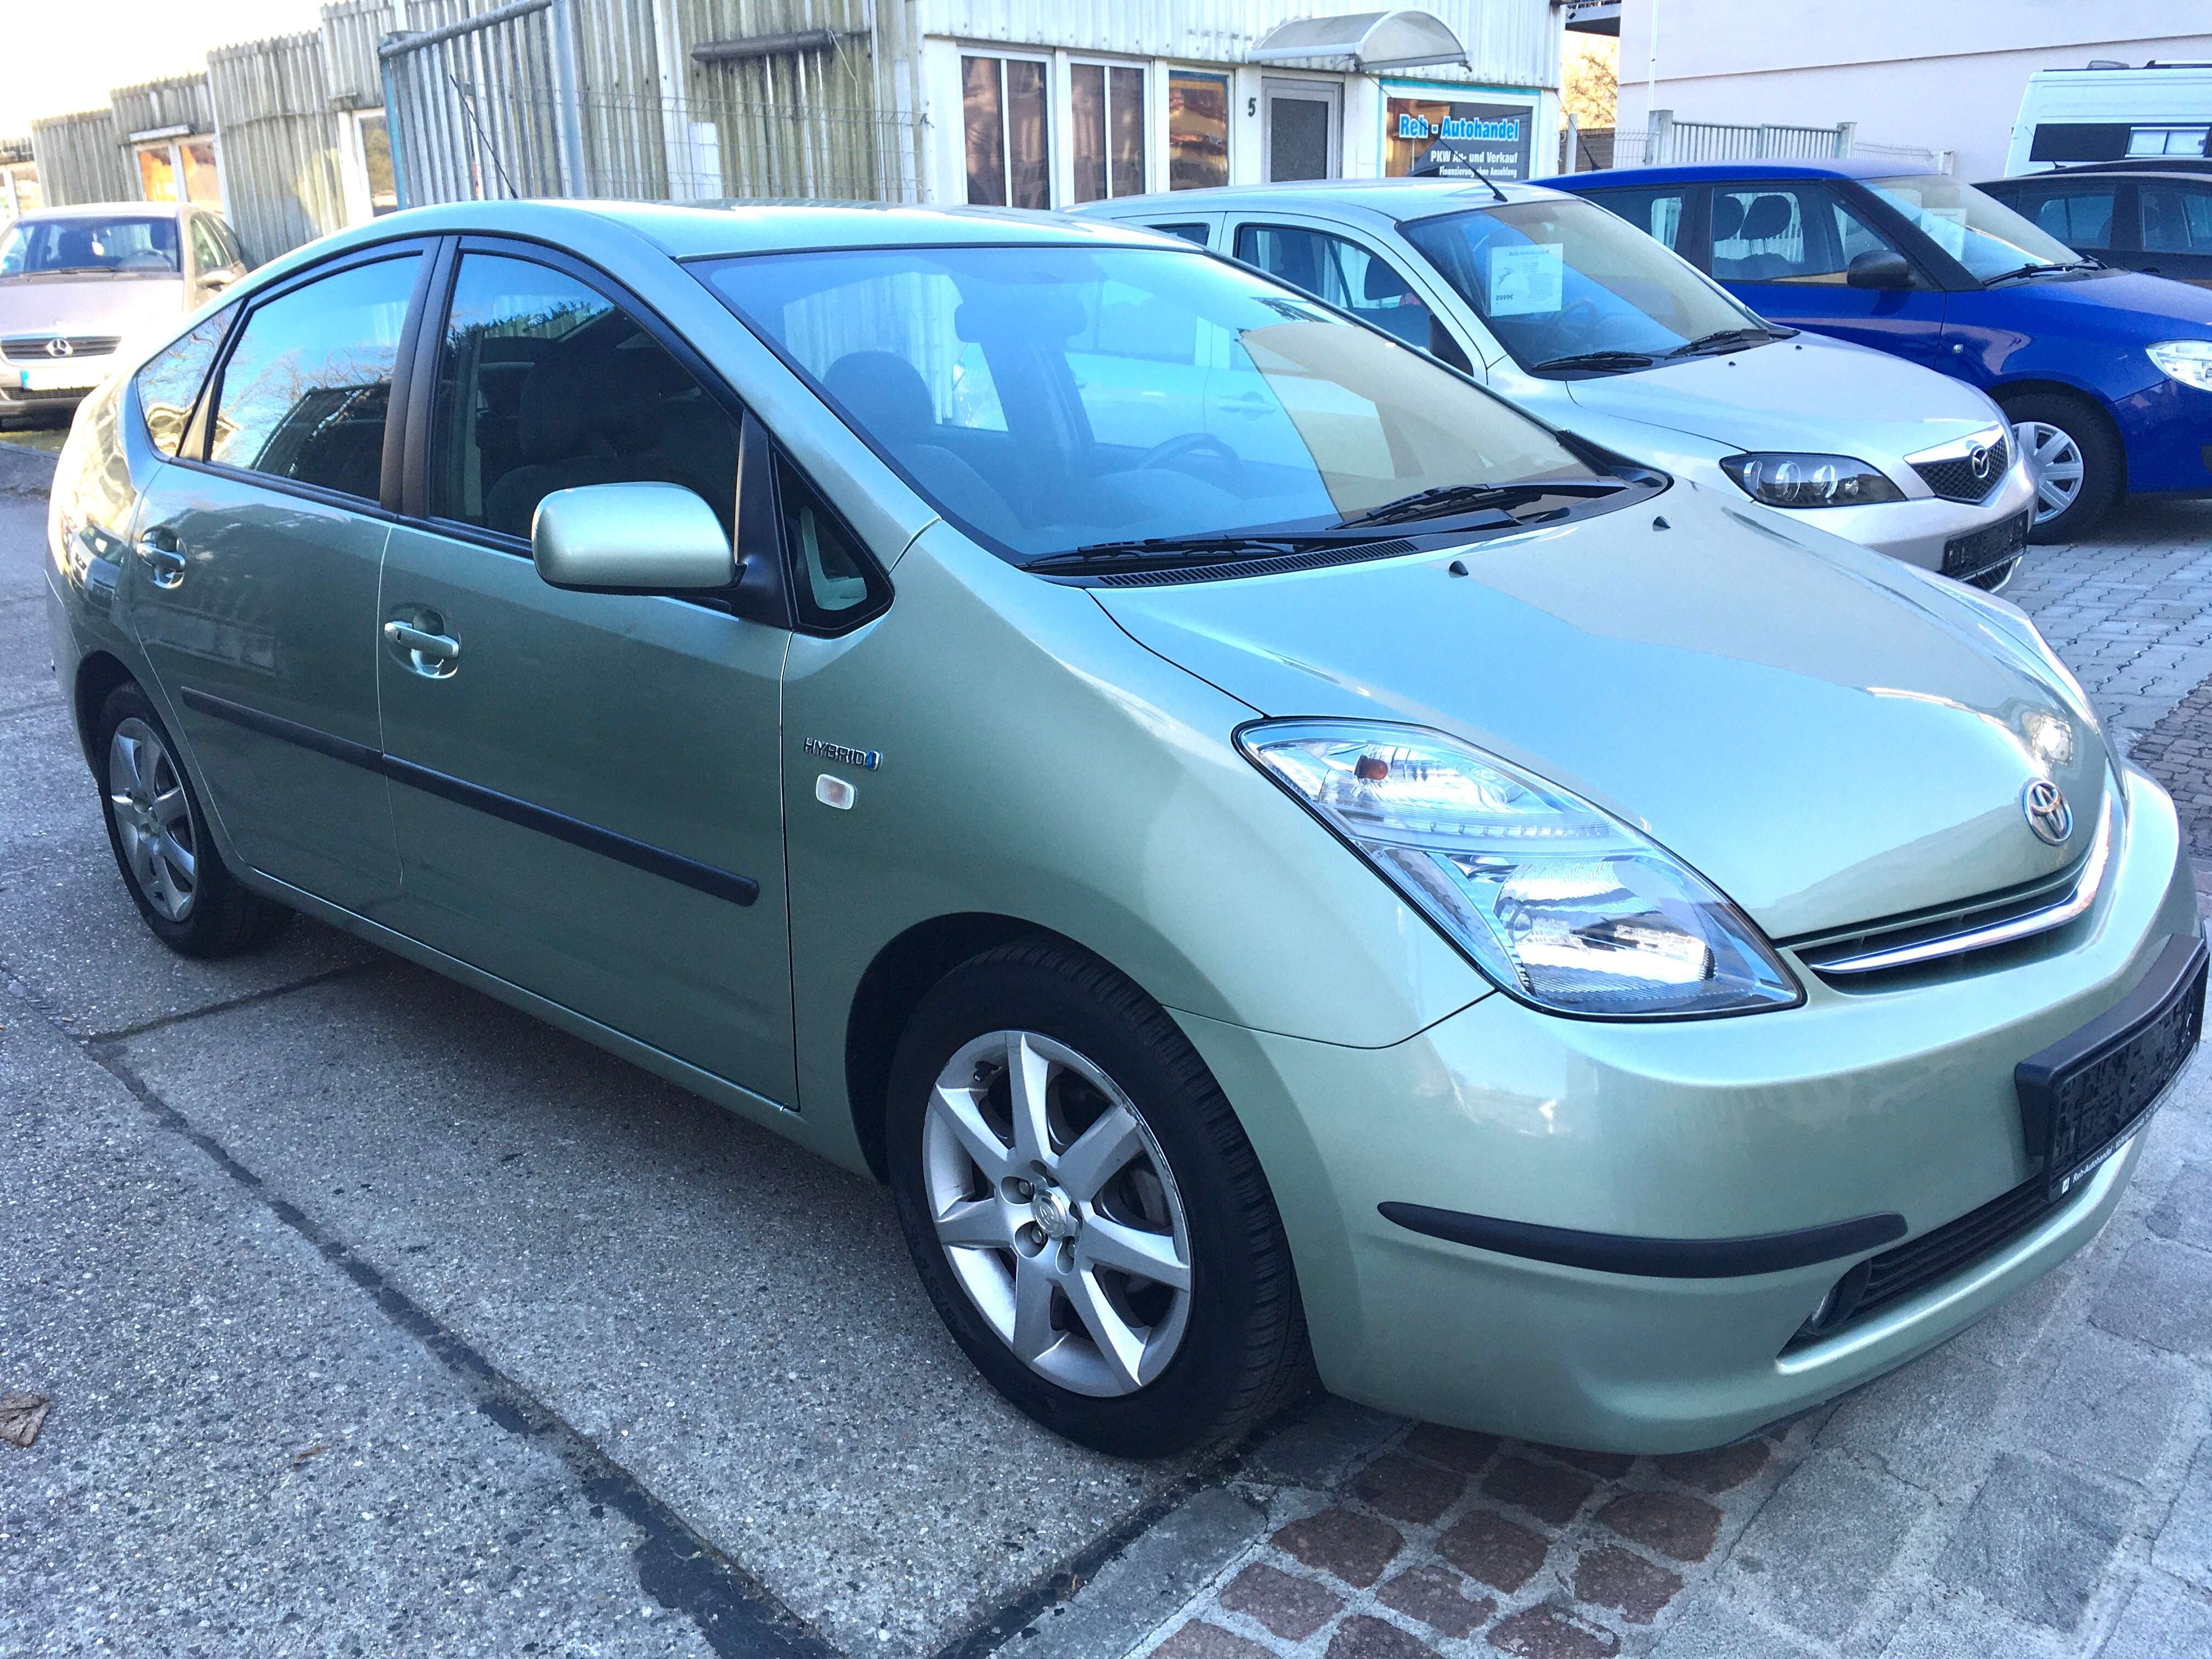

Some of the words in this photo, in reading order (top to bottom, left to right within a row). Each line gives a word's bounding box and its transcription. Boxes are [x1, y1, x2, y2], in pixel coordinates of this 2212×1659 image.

[1248, 97, 1257, 117] 5
[1399, 114, 1429, 138] Reh
[1440, 116, 1520, 142] Autohandel
[1431, 150, 1451, 162] PKW
[1469, 151, 1485, 163] und
[1486, 151, 1518, 163] Verkauf
[1440, 166, 1475, 178] Finanzierung
[1490, 166, 1517, 178] Anzahlung
[804, 737, 867, 767] HYBRID
